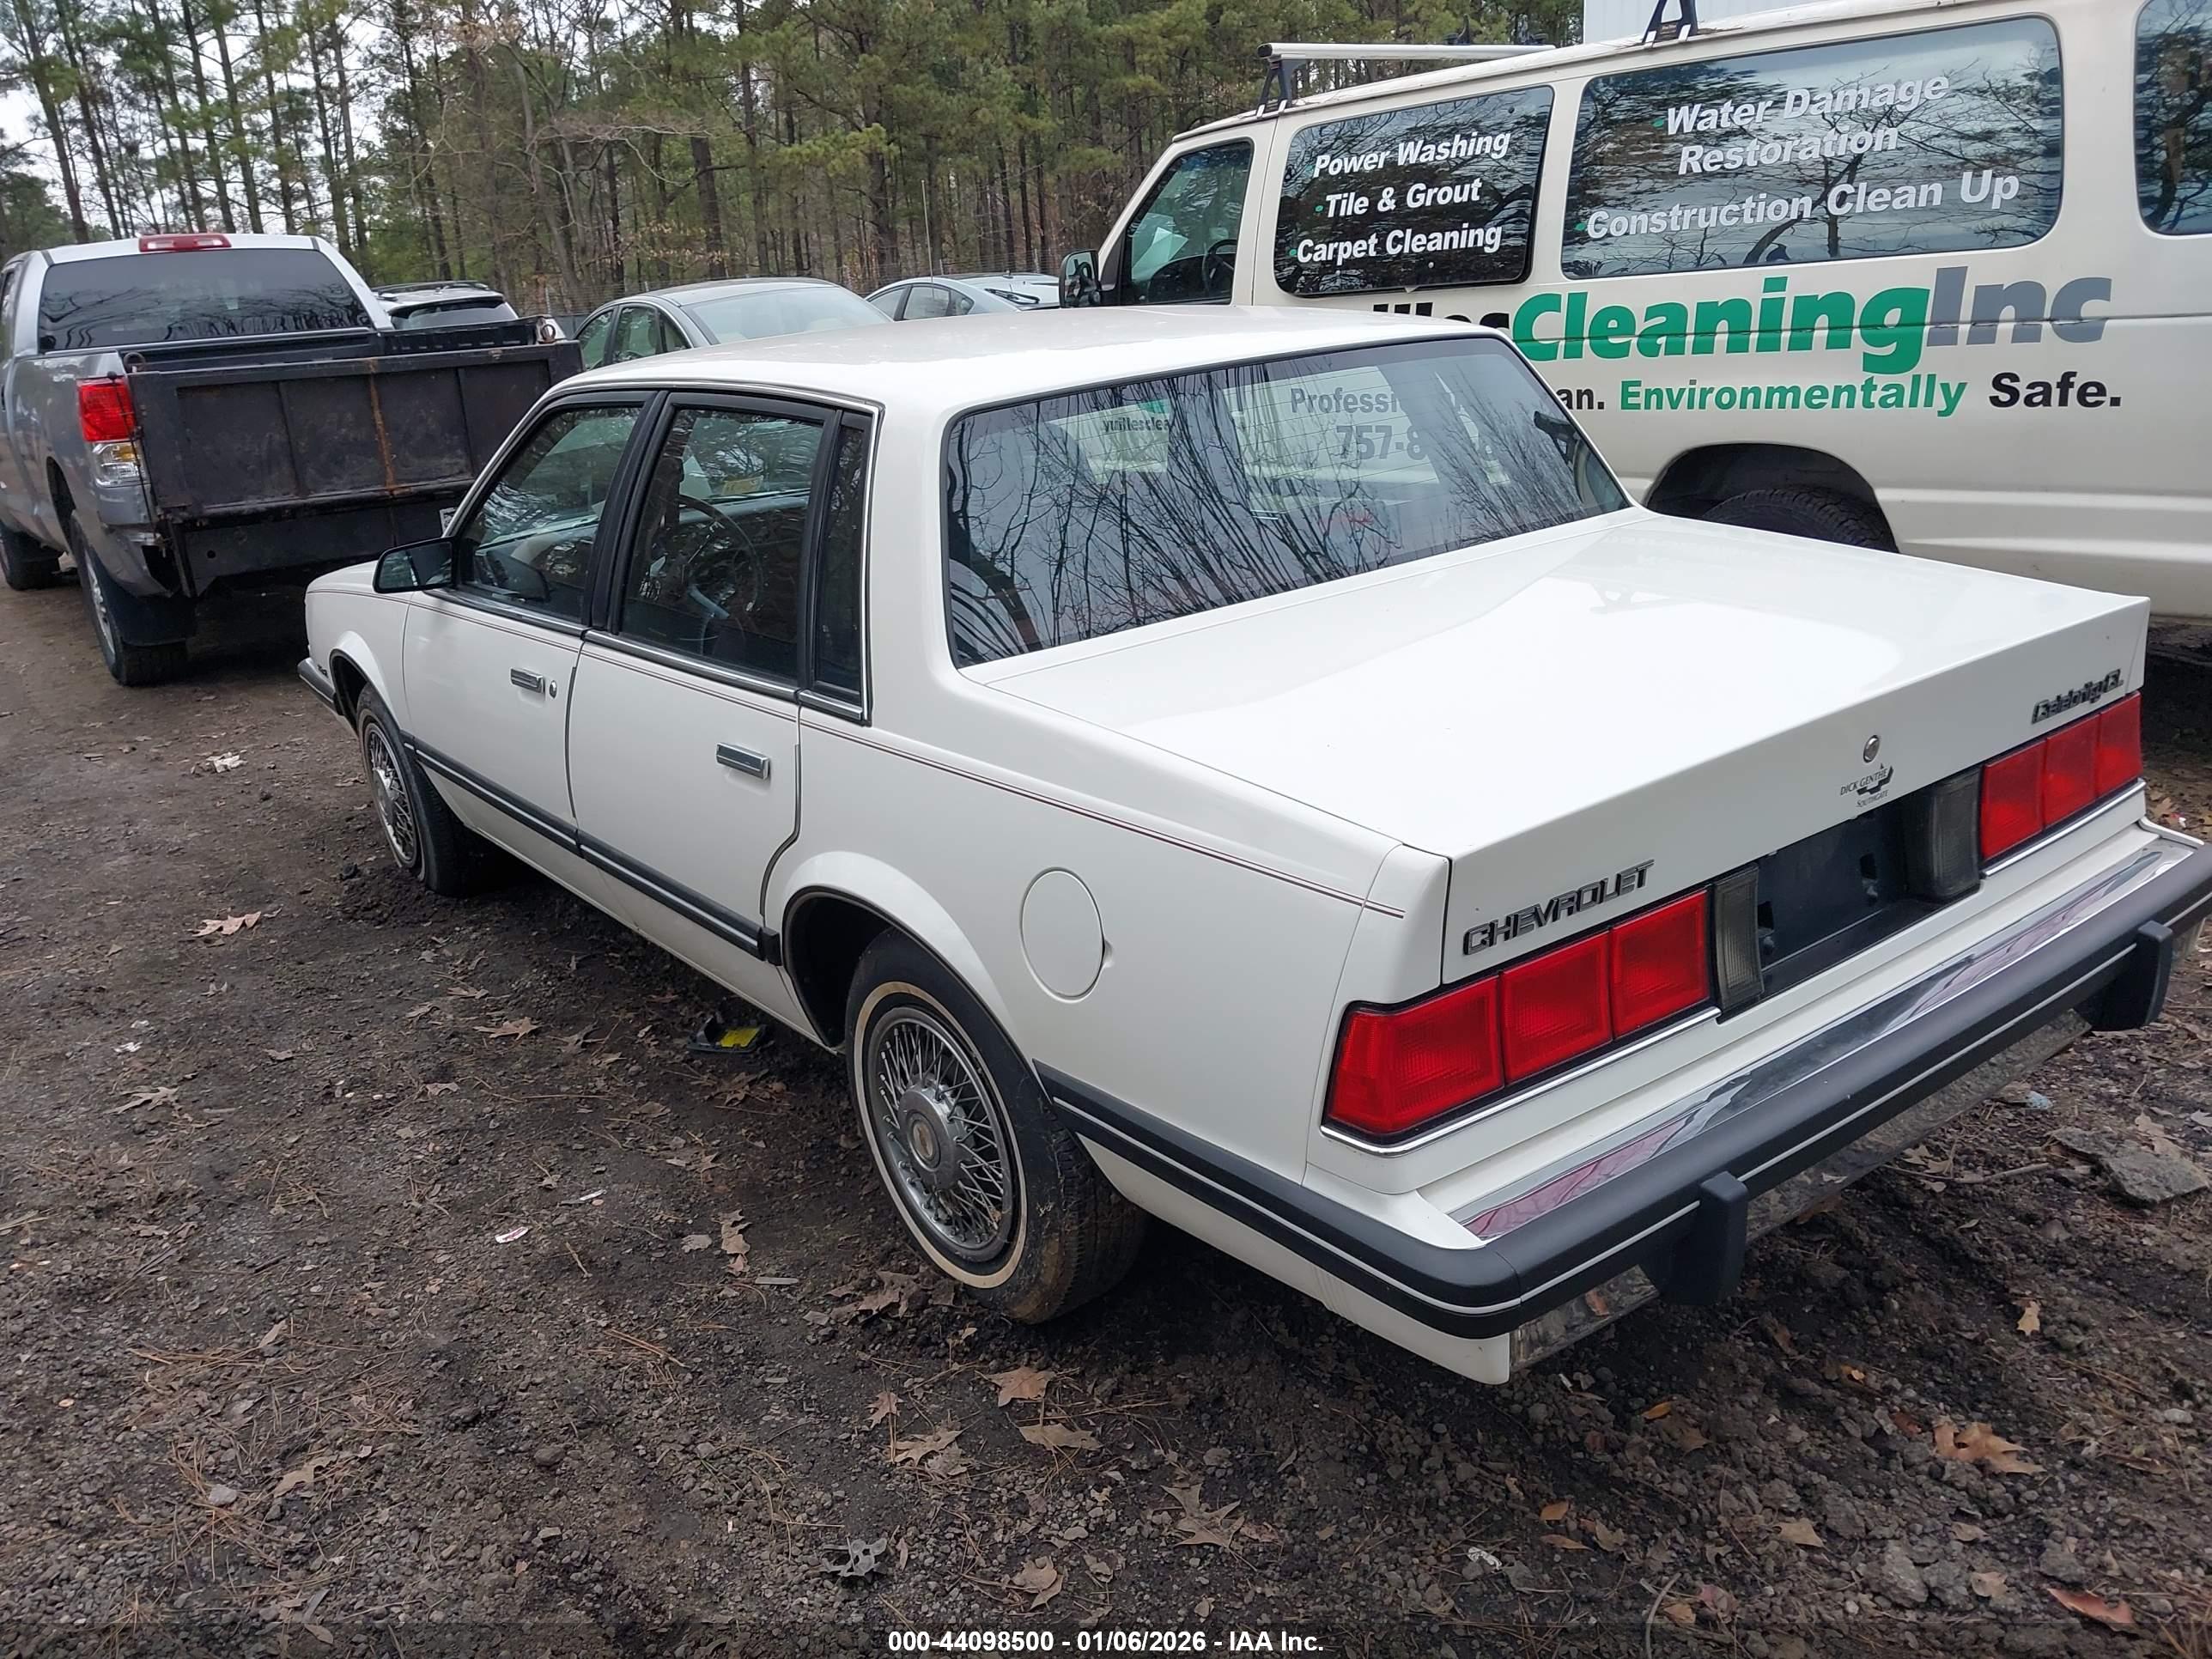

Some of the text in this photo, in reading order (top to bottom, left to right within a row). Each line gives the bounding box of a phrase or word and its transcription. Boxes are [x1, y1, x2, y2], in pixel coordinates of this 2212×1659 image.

[1667, 75, 1950, 136] Water Damage
[1312, 131, 1512, 179] Power Washing
[1678, 124, 1899, 175] Restoration
[1325, 177, 1482, 219] Tile & Grout
[1587, 170, 2021, 240] Construction Clean Up
[1297, 224, 1503, 265] Carpet Cleaning
[1620, 373, 1968, 418] Environmentally
[1988, 372, 2123, 409] Safe.
[1840, 781, 1858, 796] DICK
[1463, 859, 1655, 956] CHEVROLET
